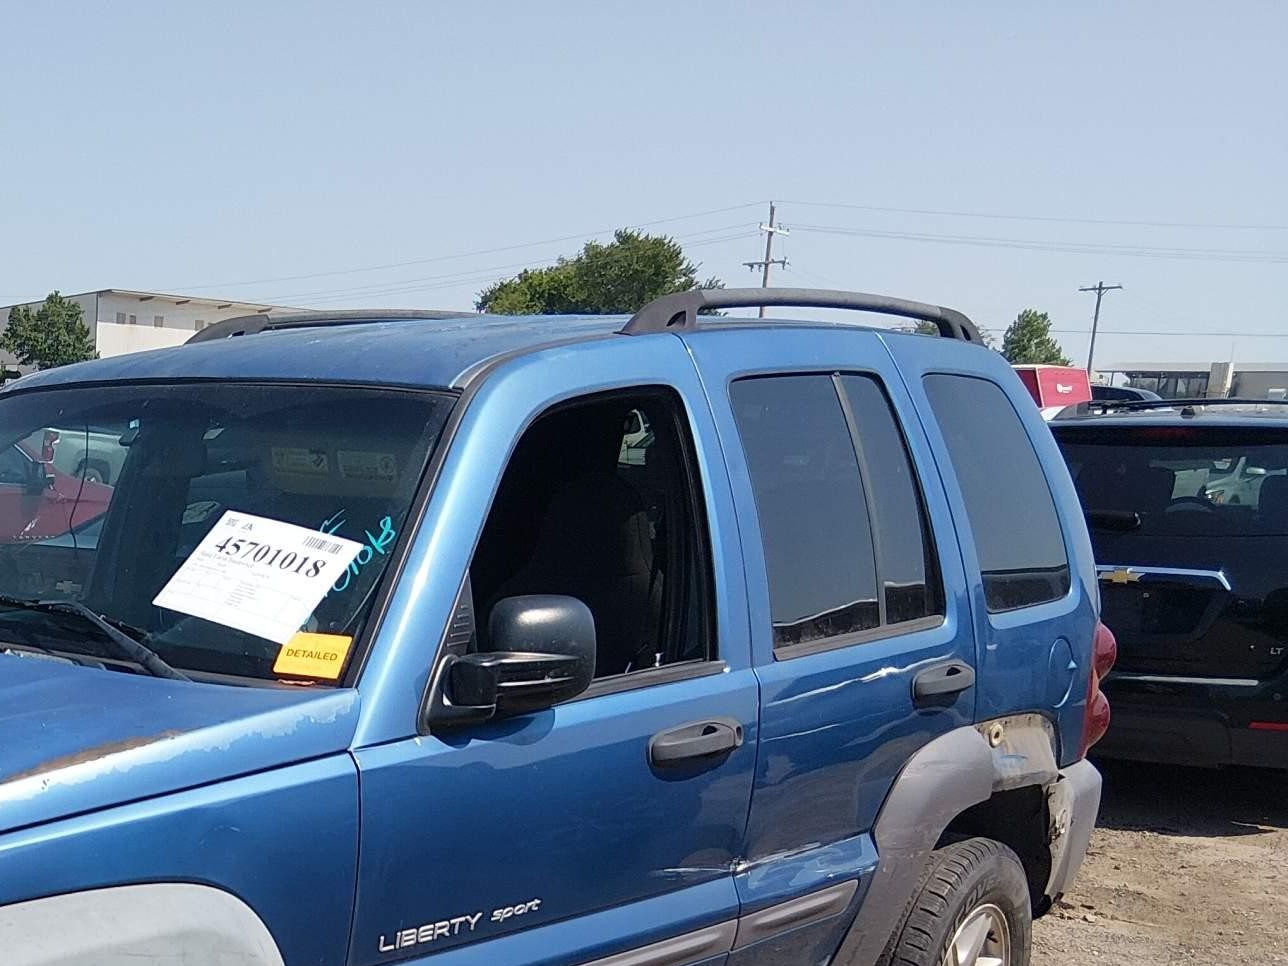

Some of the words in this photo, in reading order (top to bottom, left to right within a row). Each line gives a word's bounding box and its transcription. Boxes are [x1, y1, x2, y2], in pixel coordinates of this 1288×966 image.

[215, 536, 328, 580] 45701018
[286, 648, 338, 661] DETAILED
[1270, 647, 1284, 655] LT
[378, 912, 483, 953] LIBERTY
[490, 898, 542, 922] sport
